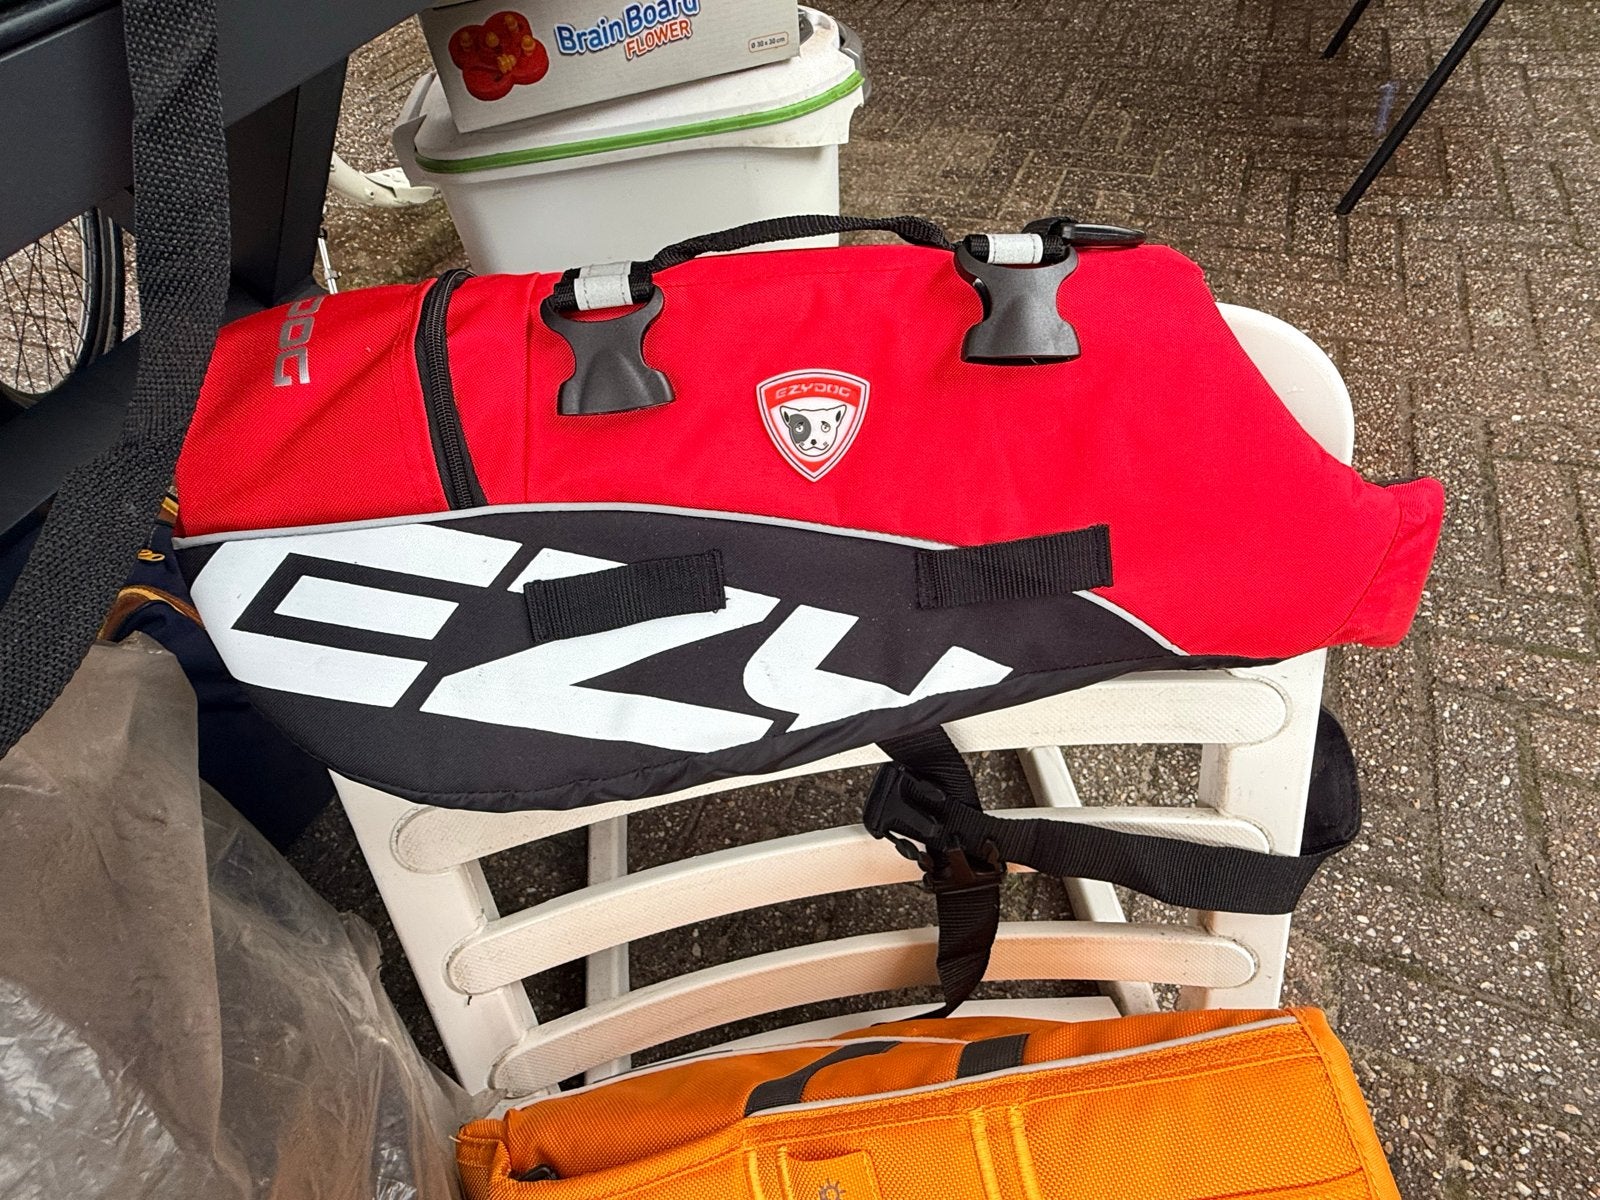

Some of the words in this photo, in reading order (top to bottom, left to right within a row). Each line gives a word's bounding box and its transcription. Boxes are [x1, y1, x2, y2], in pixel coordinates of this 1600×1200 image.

[556, 17, 624, 54] Brain
[625, 18, 692, 60] FLOWER
[775, 382, 852, 400] EZYDOG
